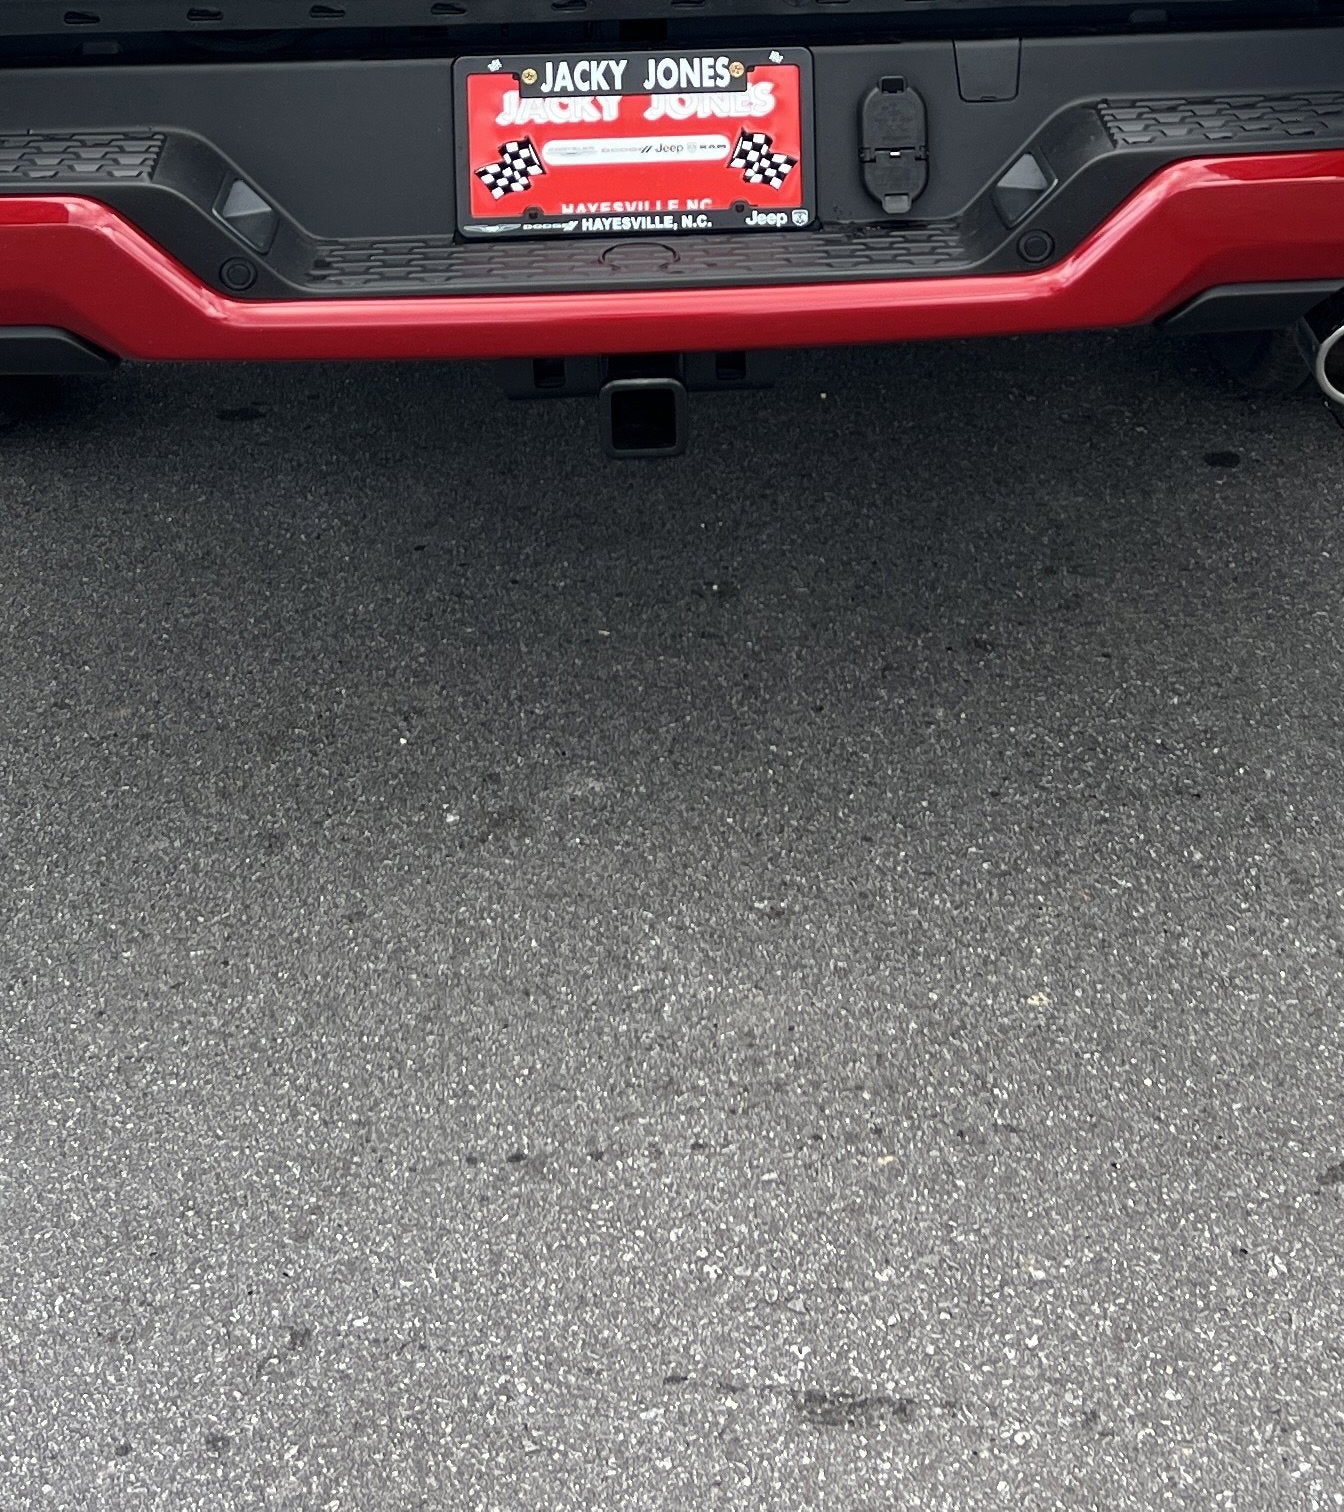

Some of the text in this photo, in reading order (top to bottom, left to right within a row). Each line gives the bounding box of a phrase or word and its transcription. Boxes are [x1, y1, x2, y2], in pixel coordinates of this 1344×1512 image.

[540, 56, 732, 93] JACKY JONES
[495, 81, 776, 126] JACKY JONES
[655, 143, 684, 153] Jeep
[681, 214, 713, 228] N.C.
[745, 210, 788, 227] Jeep
